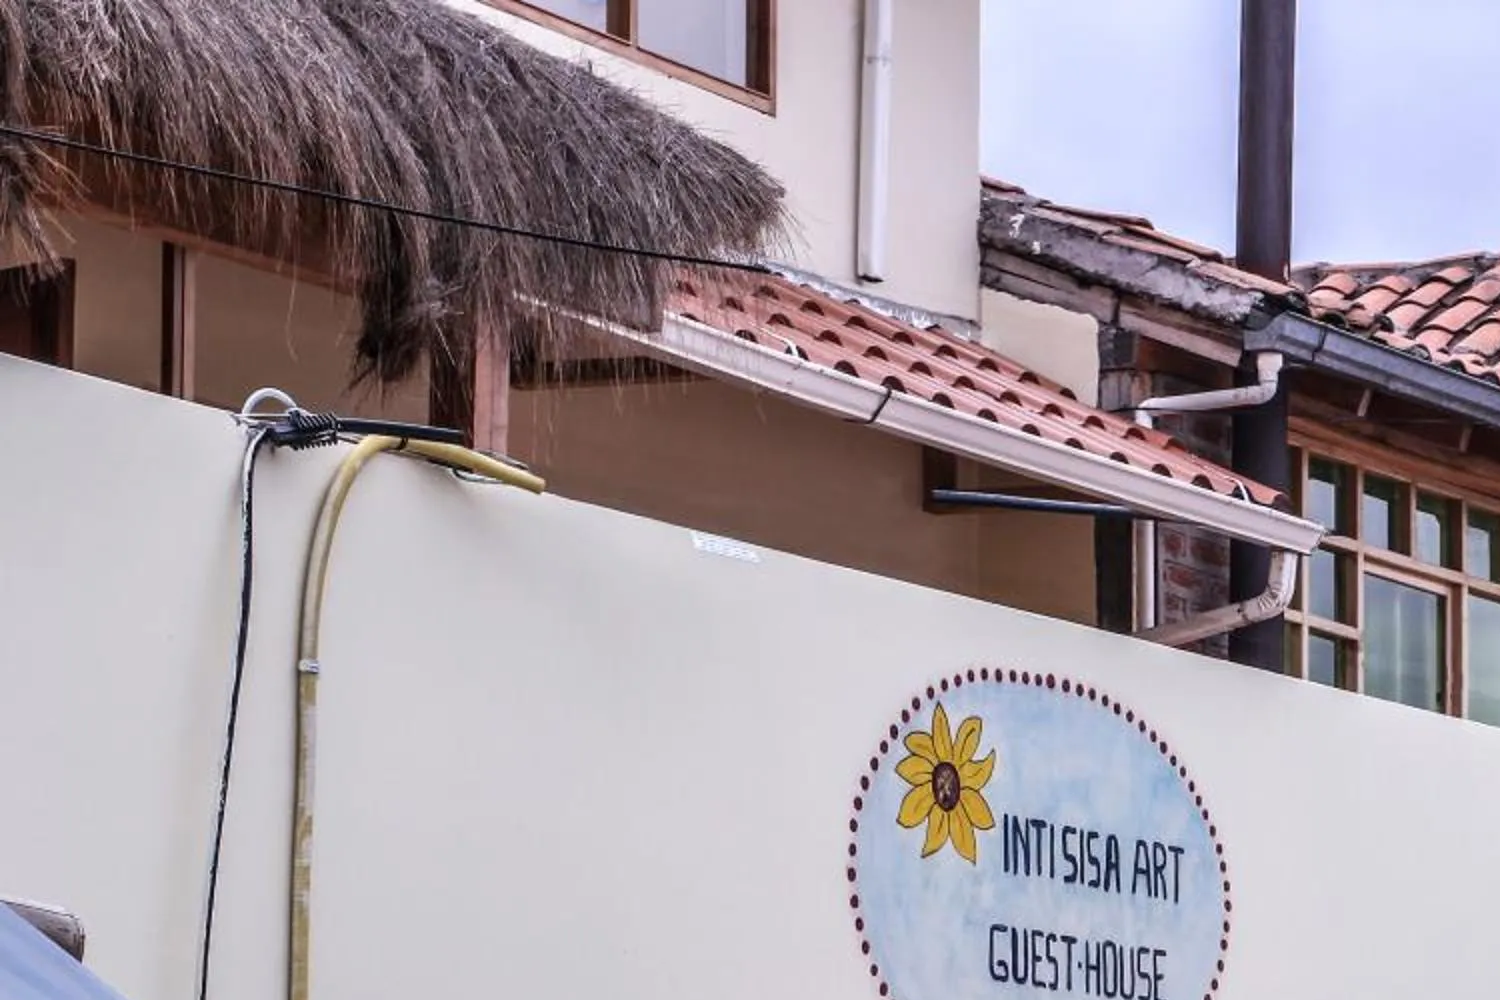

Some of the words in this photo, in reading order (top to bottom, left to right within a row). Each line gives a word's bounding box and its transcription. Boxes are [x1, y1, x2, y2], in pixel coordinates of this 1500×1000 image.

[1003, 813, 1056, 879] INTI
[1062, 826, 1121, 893] SISA
[1131, 839, 1185, 904] ART
